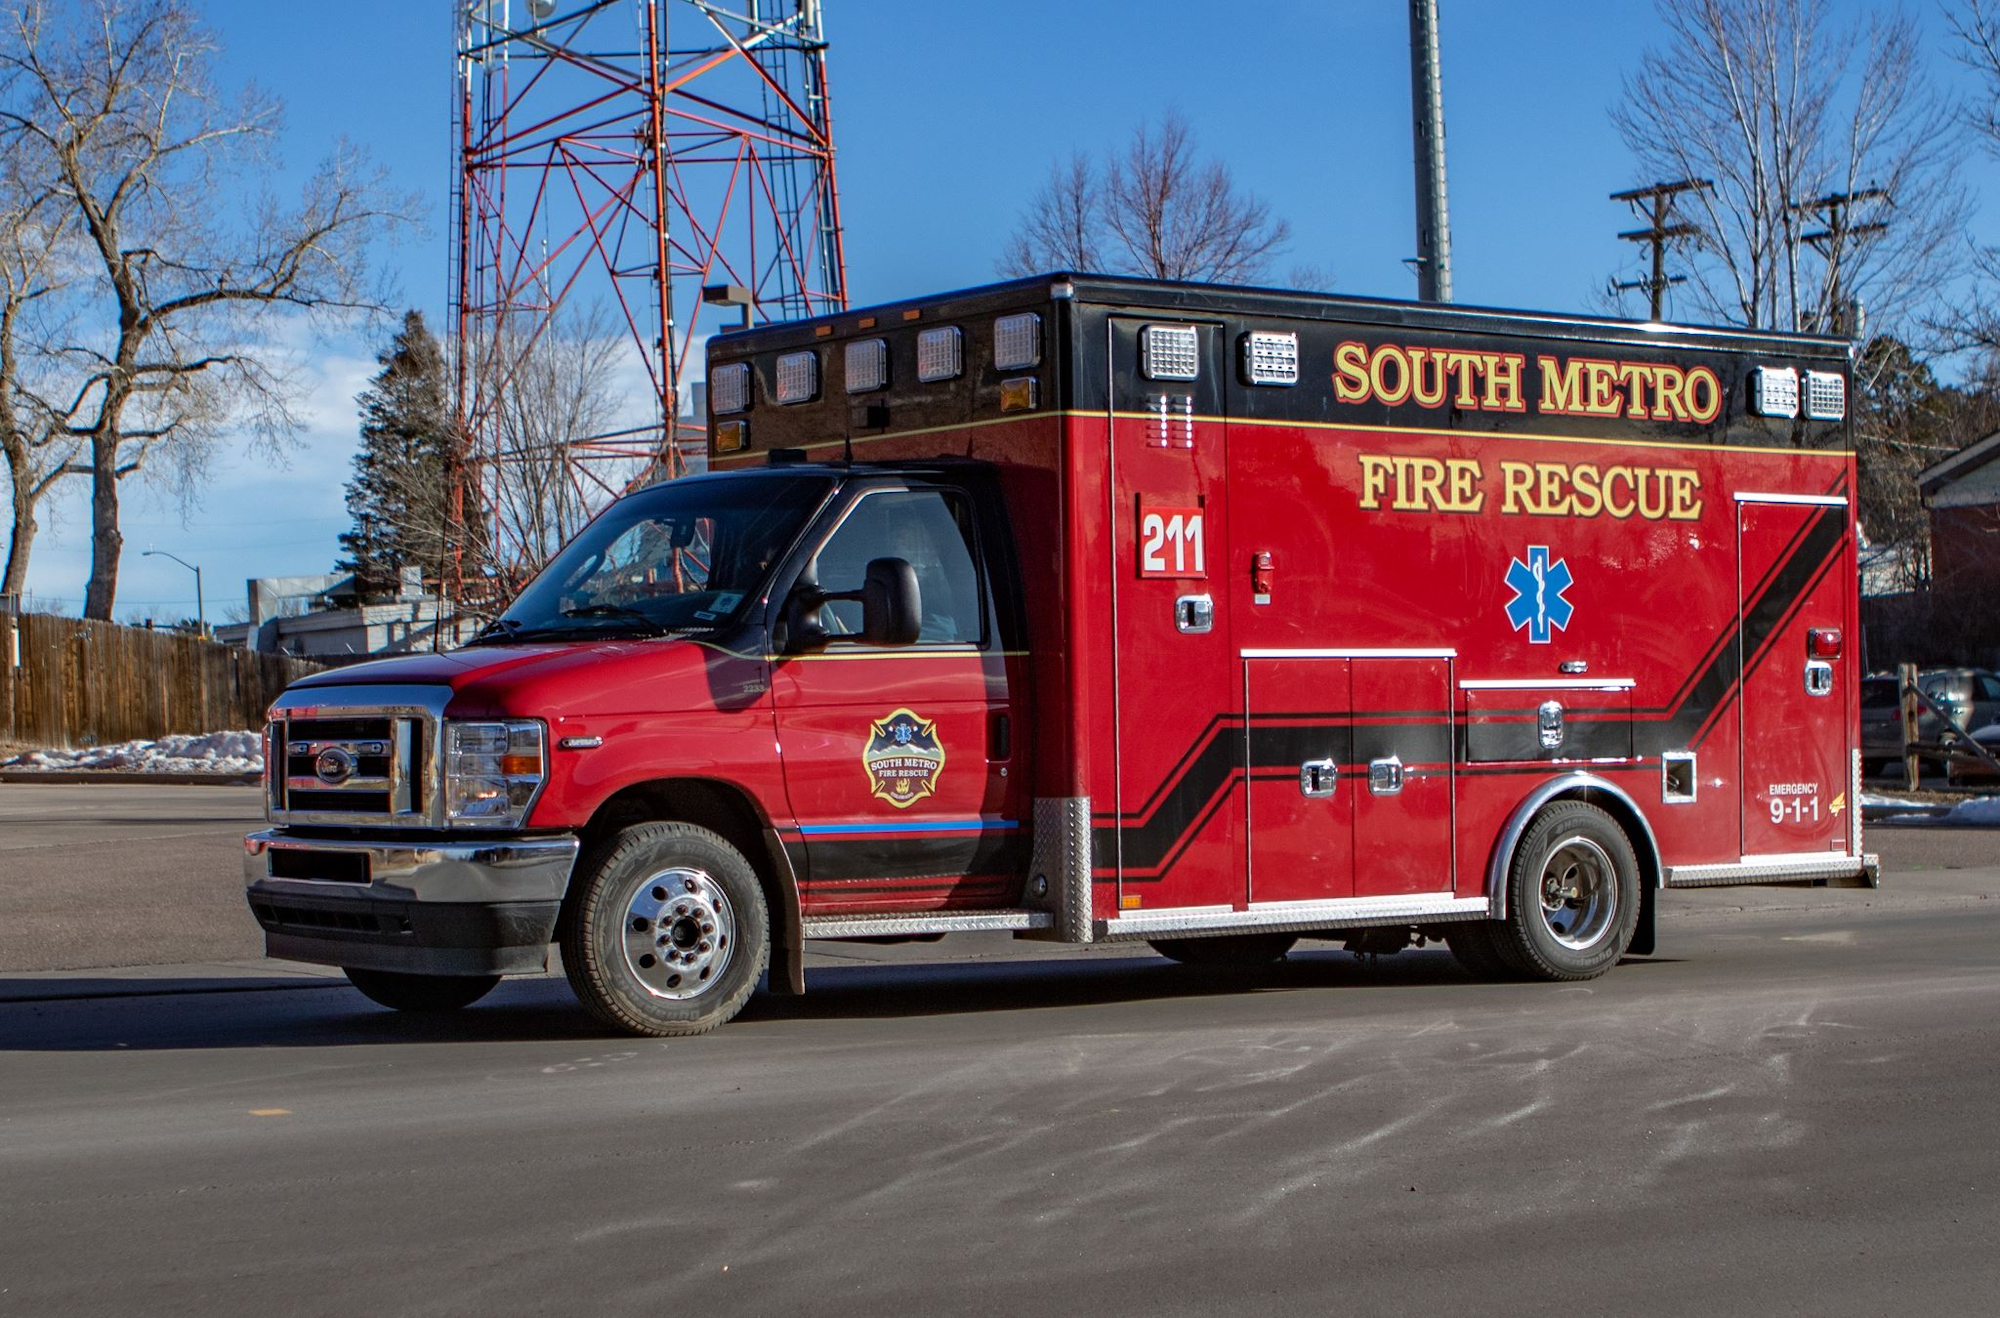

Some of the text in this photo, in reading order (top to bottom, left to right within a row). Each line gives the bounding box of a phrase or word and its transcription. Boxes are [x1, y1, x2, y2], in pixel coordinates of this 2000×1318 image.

[1333, 342, 1721, 423] SOUTH METRO
[1357, 453, 1703, 521] FIRE RESCUE
[1143, 513, 1203, 572] 211
[871, 758, 938, 771] SOUTH METRO
[879, 769, 929, 777] FIRE RESCUE
[1769, 783, 1818, 795] EMERGENCY
[1770, 796, 1819, 824] 9-1-1
